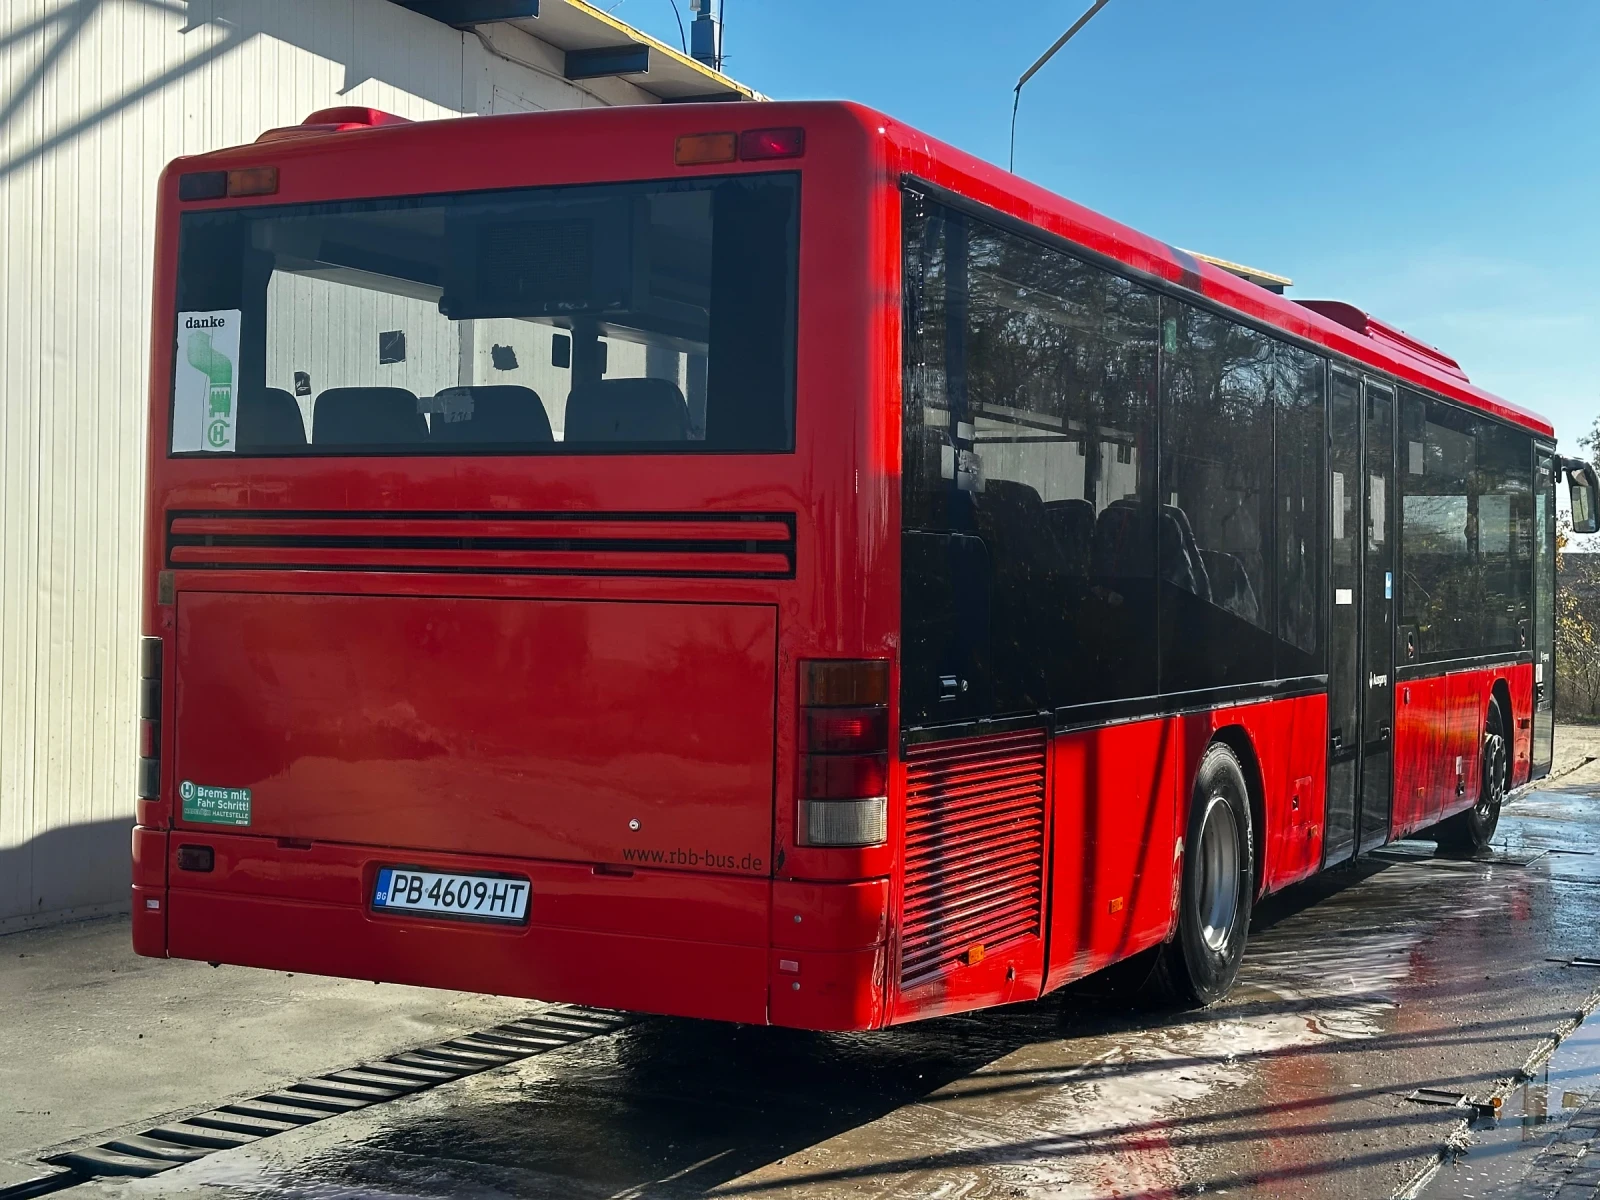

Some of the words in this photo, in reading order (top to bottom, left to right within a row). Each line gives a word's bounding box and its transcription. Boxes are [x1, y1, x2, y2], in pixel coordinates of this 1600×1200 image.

[185, 316, 225, 328] danke
[197, 787, 228, 799] Brems
[230, 790, 250, 801] mit.
[197, 798, 215, 808] Fahr
[217, 800, 249, 811] Schritt!
[212, 810, 249, 819] HALTESTELLE
[622, 848, 762, 871] www.rbb-bus.de
[376, 891, 387, 900] BG
